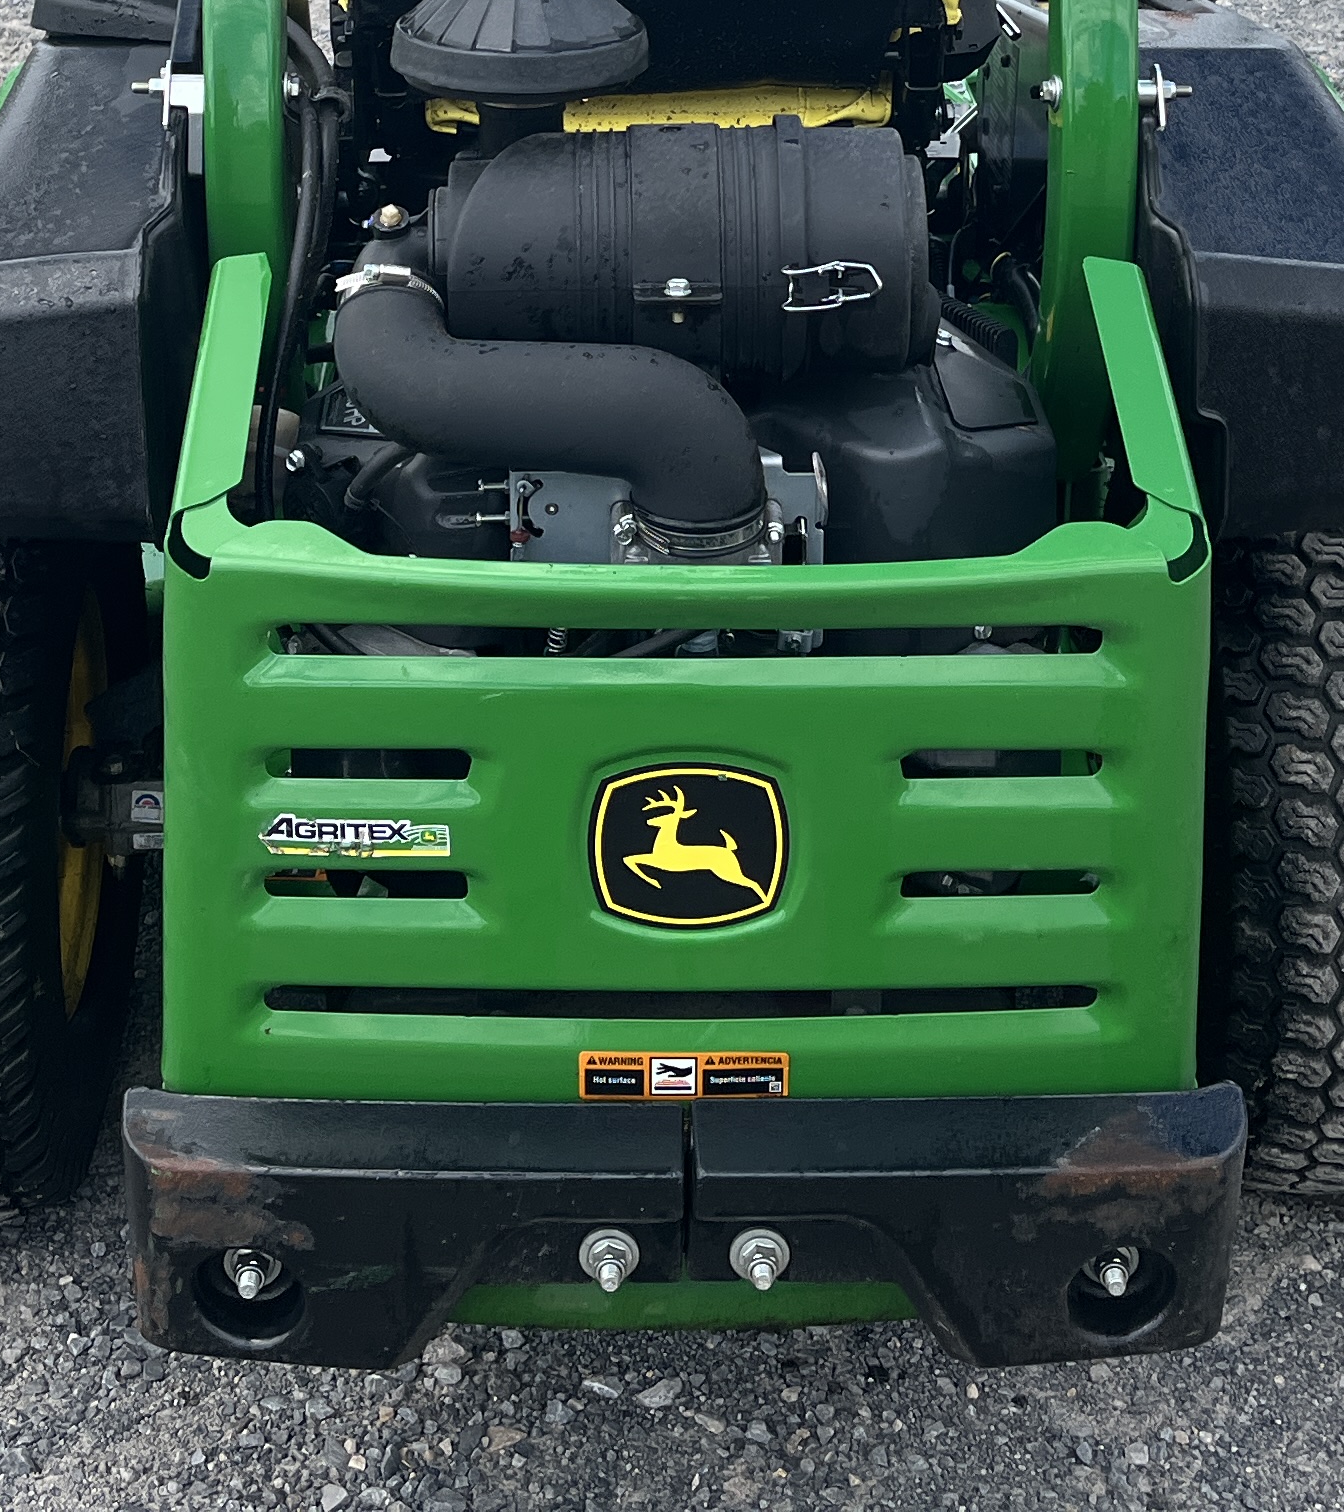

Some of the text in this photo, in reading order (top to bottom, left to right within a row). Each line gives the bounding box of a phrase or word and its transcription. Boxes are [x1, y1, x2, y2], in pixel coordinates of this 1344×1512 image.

[264, 817, 409, 841] AGRITEX
[598, 1056, 644, 1066] WARNING
[718, 1056, 783, 1066] ADVERTENCIA
[593, 1076, 636, 1085] Hot surface
